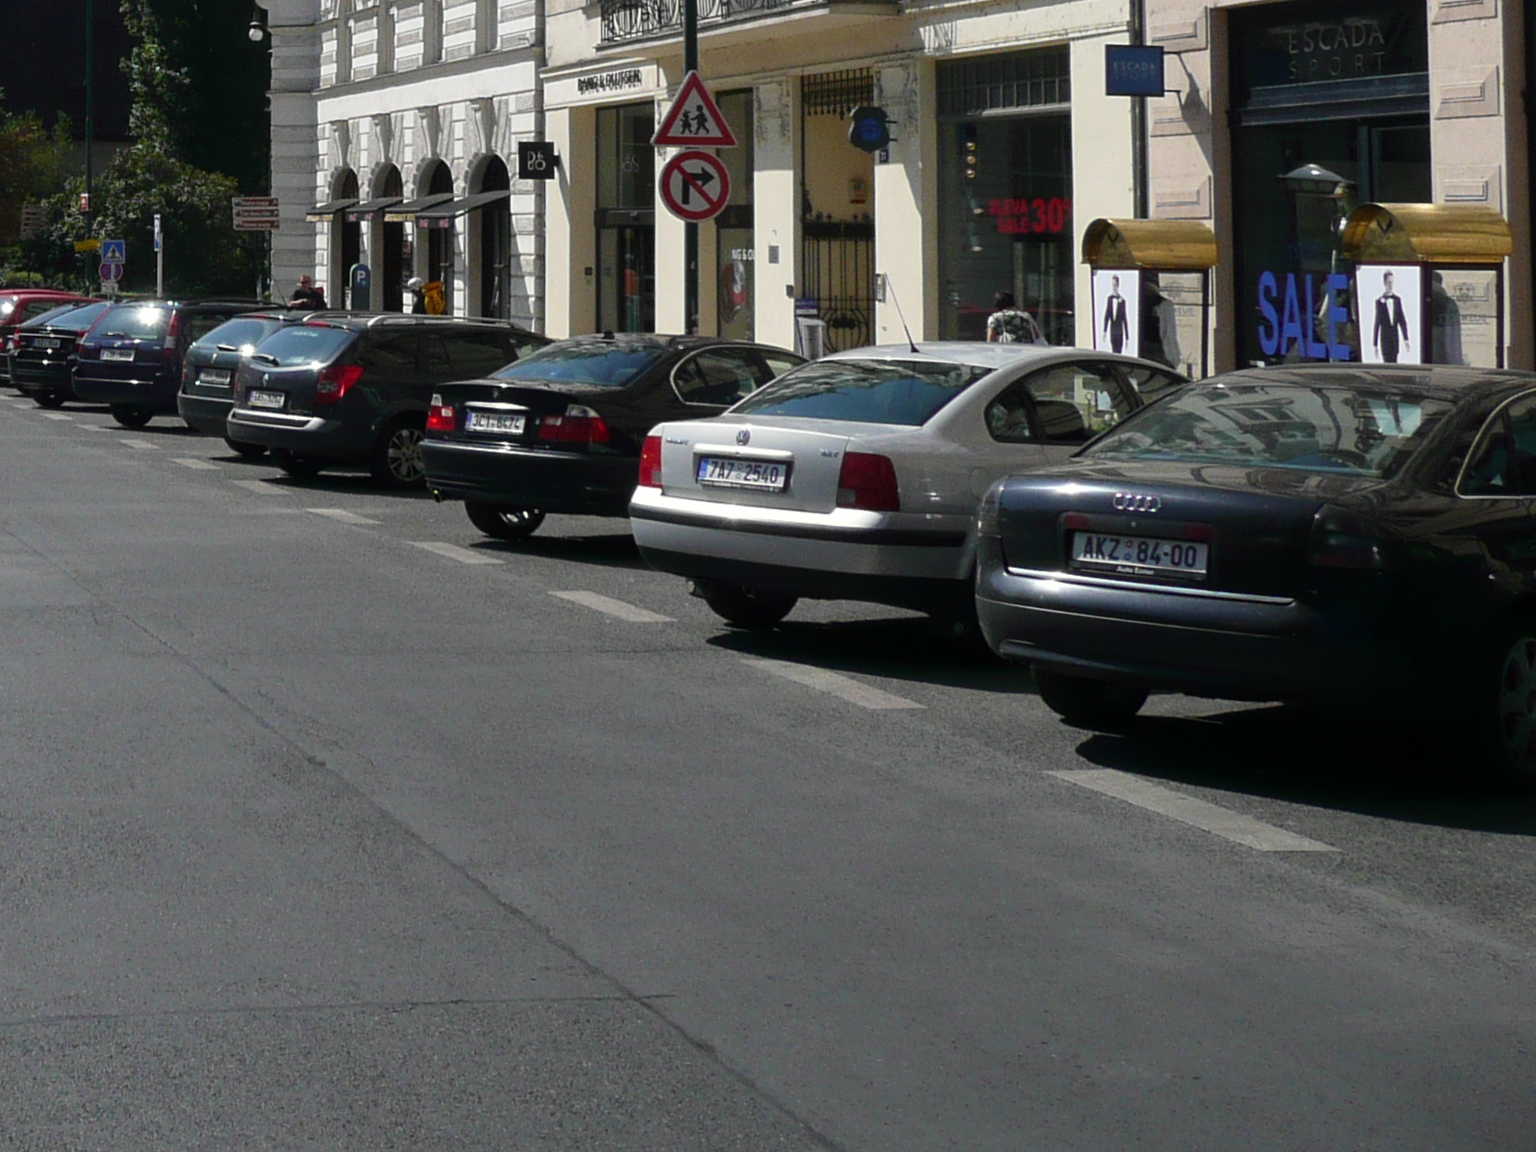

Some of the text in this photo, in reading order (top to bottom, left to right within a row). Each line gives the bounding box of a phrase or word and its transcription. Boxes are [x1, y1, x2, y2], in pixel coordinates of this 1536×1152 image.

[1288, 21, 1385, 54] ESCADA
[1113, 61, 1156, 70] ESCADA
[1288, 52, 1386, 79] SPORT
[1257, 270, 1351, 361] SALE
[708, 459, 780, 484] 7A7 2540
[1083, 535, 1197, 568] AKZ 84-00
